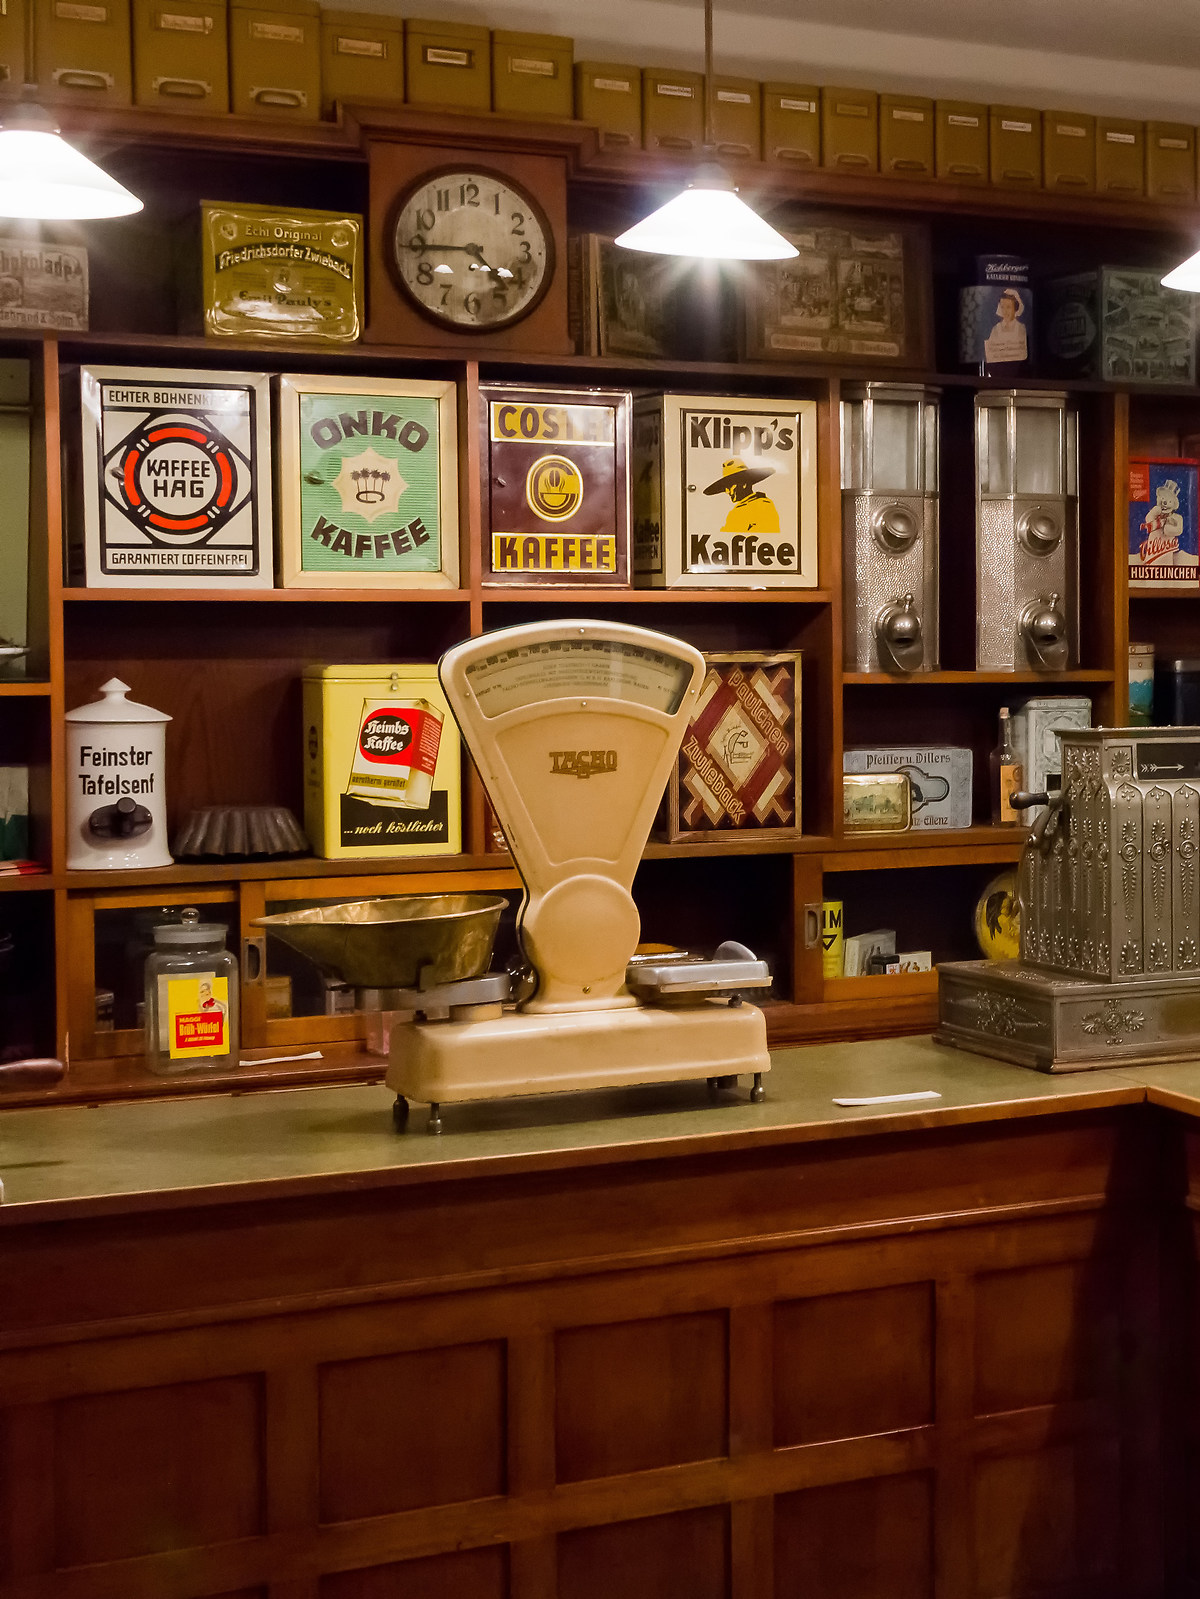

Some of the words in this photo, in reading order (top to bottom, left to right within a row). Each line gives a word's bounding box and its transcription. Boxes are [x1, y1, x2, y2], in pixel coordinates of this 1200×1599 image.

[436, 188, 450, 212] 11
[459, 183, 480, 207] 12
[493, 192, 501, 215] 1
[415, 208, 436, 231] 10
[511, 212, 526, 236] 2
[273, 226, 323, 242] Original
[518, 240, 533, 264] 3
[415, 261, 434, 286] 8
[439, 283, 453, 306] 7
[463, 291, 481, 315] 6
[109, 390, 151, 404] ECHTER
[310, 410, 430, 453] ONKO
[690, 416, 794, 456] Klipp's
[146, 459, 211, 478] KAFFEE
[153, 479, 205, 498] HAG
[310, 515, 431, 559] KAFFEE
[111, 552, 180, 566] GARANTIERT
[181, 553, 248, 566] COFFEINFREI
[499, 536, 610, 569] KAFFEE
[690, 534, 795, 566] Kaffee
[1130, 566, 1198, 579] HUSTELINCHEN
[364, 719, 411, 736] Heimbs
[363, 735, 404, 752] Kaffee
[80, 746, 153, 767] Feinster
[548, 750, 618, 771] TACHO
[866, 753, 904, 769] Pfeiffer
[915, 752, 951, 764] Dillers
[78, 773, 155, 796] Tafelsenf
[682, 734, 746, 825] Zwieback
[385, 819, 444, 835] köstlicher
